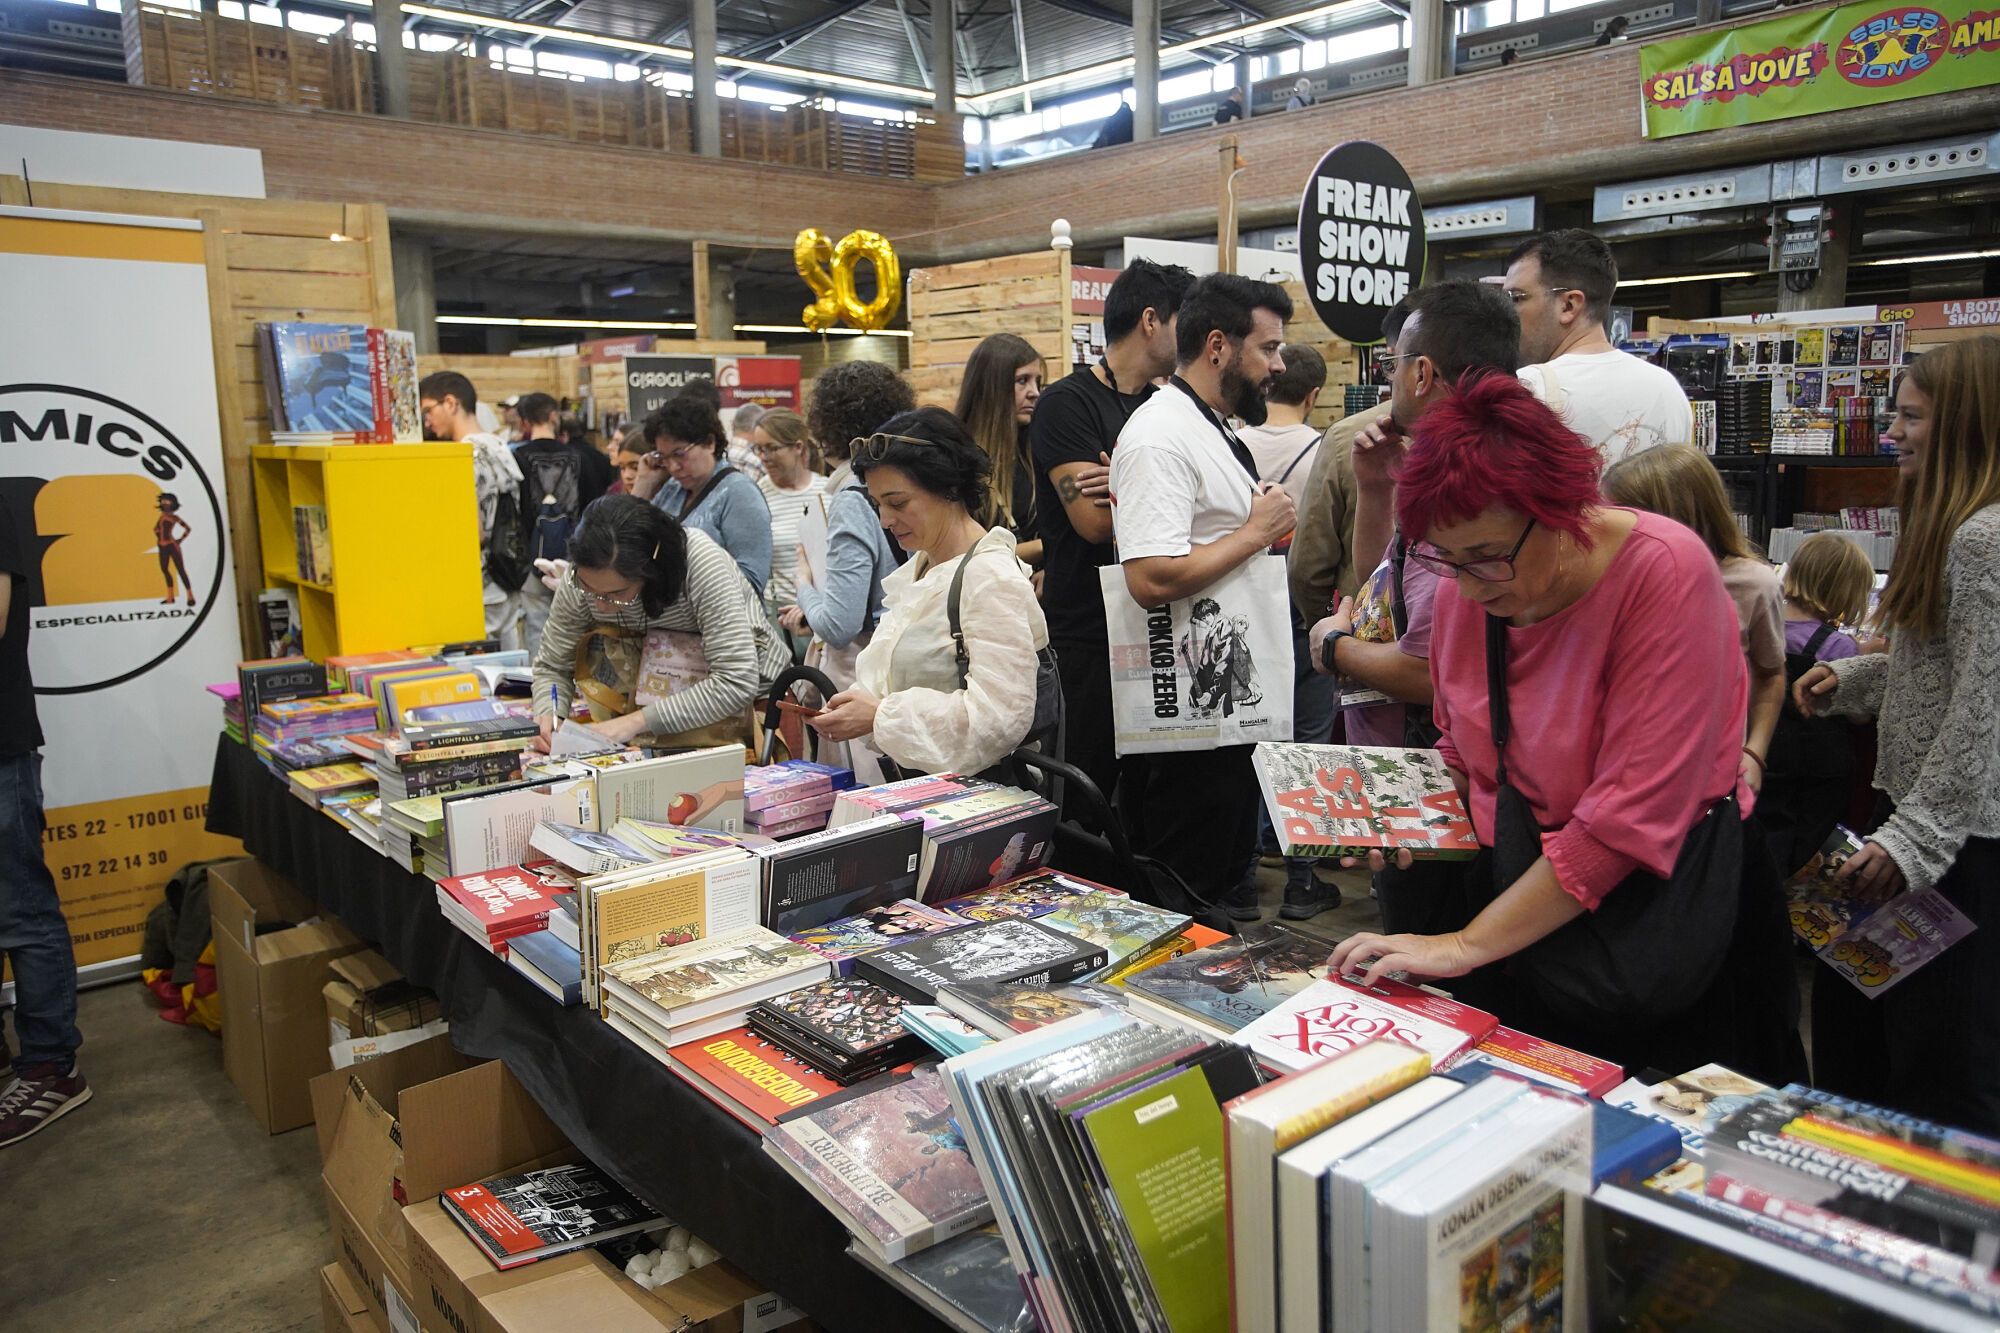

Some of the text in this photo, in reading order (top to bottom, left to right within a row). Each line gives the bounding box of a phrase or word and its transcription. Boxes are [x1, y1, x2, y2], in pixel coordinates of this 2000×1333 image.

[1653, 51, 1813, 102] SALSA JOVE
[1317, 176, 1411, 226] FREAK
[1319, 219, 1410, 267] SHOW
[1316, 262, 1410, 307] STORE
[1943, 302, 1961, 314] LA
[35, 608, 196, 630] ESPECIALITZADA
[438, 736, 473, 745] LIGHTFALL
[85, 819, 107, 837] 22
[127, 808, 176, 830] 17001
[61, 849, 168, 881] 972 22 14 30
[911, 965, 957, 988] lack
[703, 1039, 819, 1107] UNDERGROUND
[806, 1135, 897, 1207] BLUEBERRY
